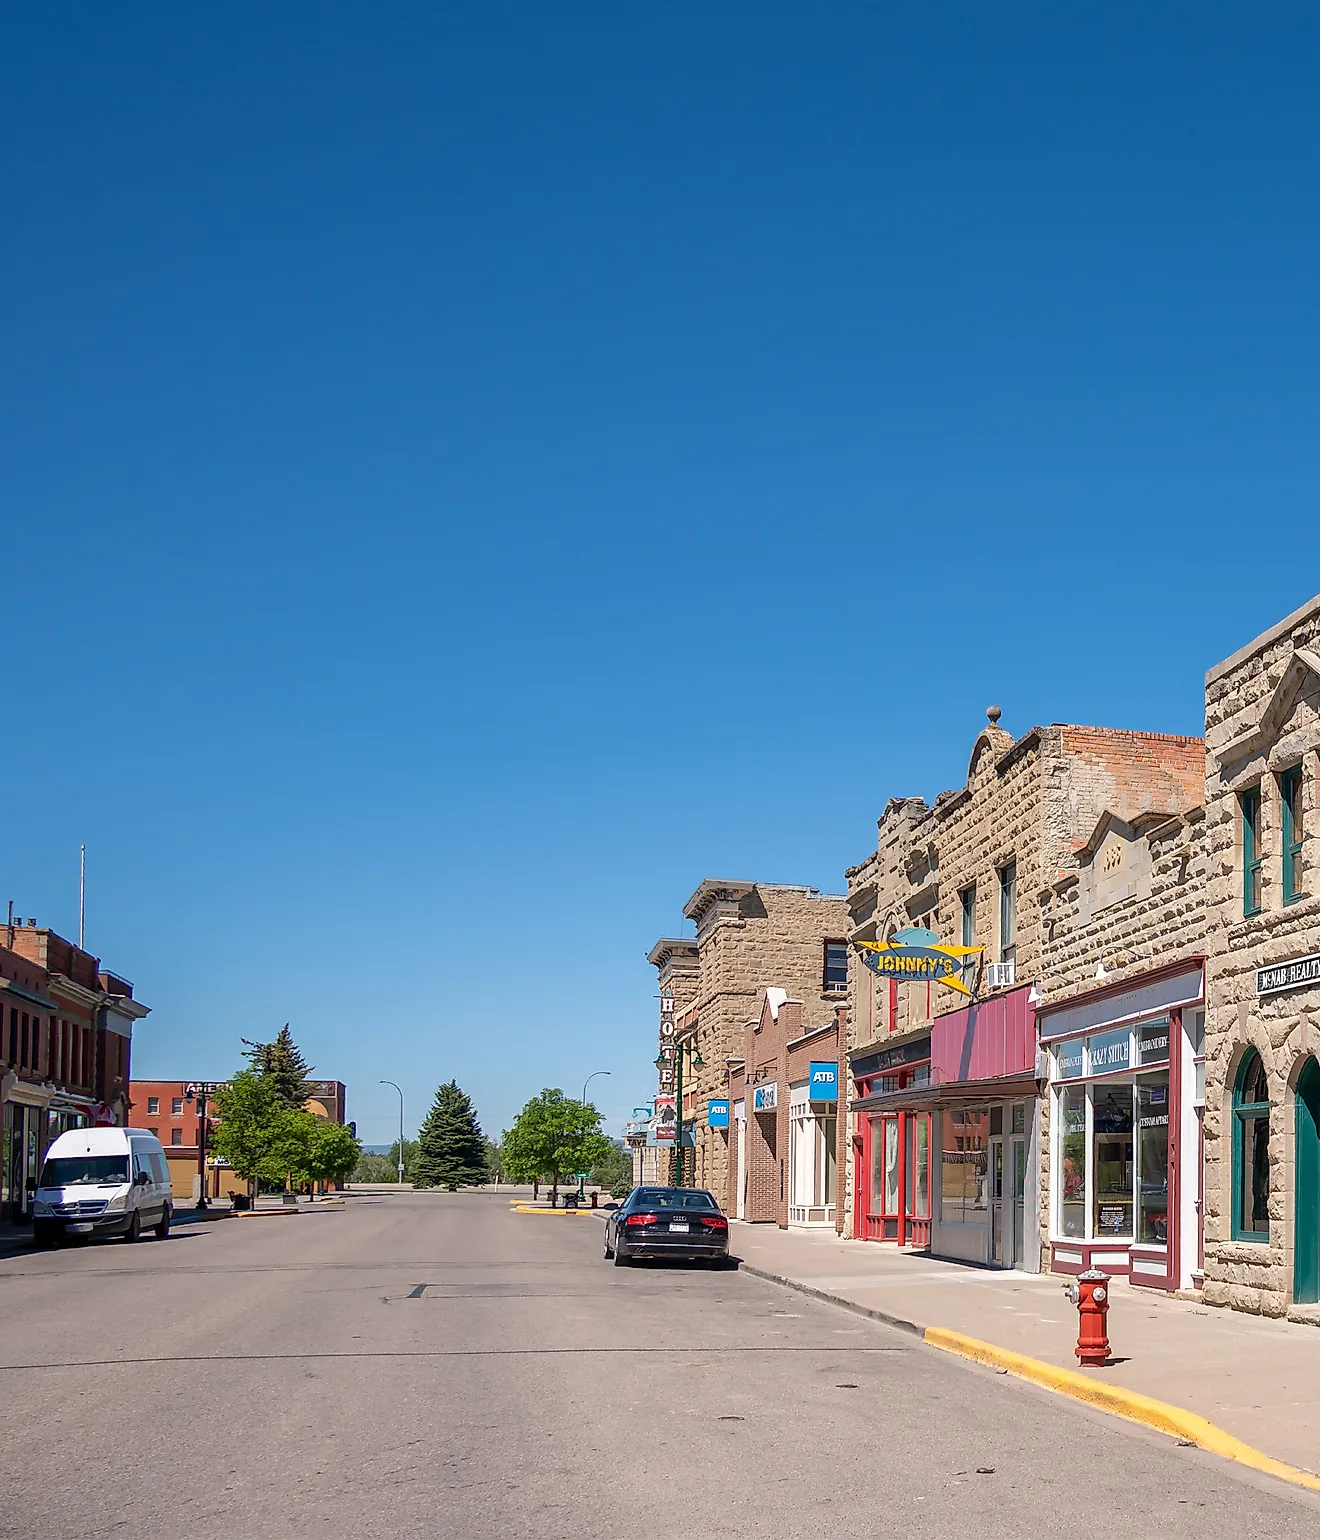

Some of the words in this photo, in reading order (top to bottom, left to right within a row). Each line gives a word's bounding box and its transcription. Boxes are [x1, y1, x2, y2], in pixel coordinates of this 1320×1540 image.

[877, 955, 953, 973] JOHNNY'S
[813, 1071, 835, 1082] ATB
[711, 1106, 727, 1114] ATB
